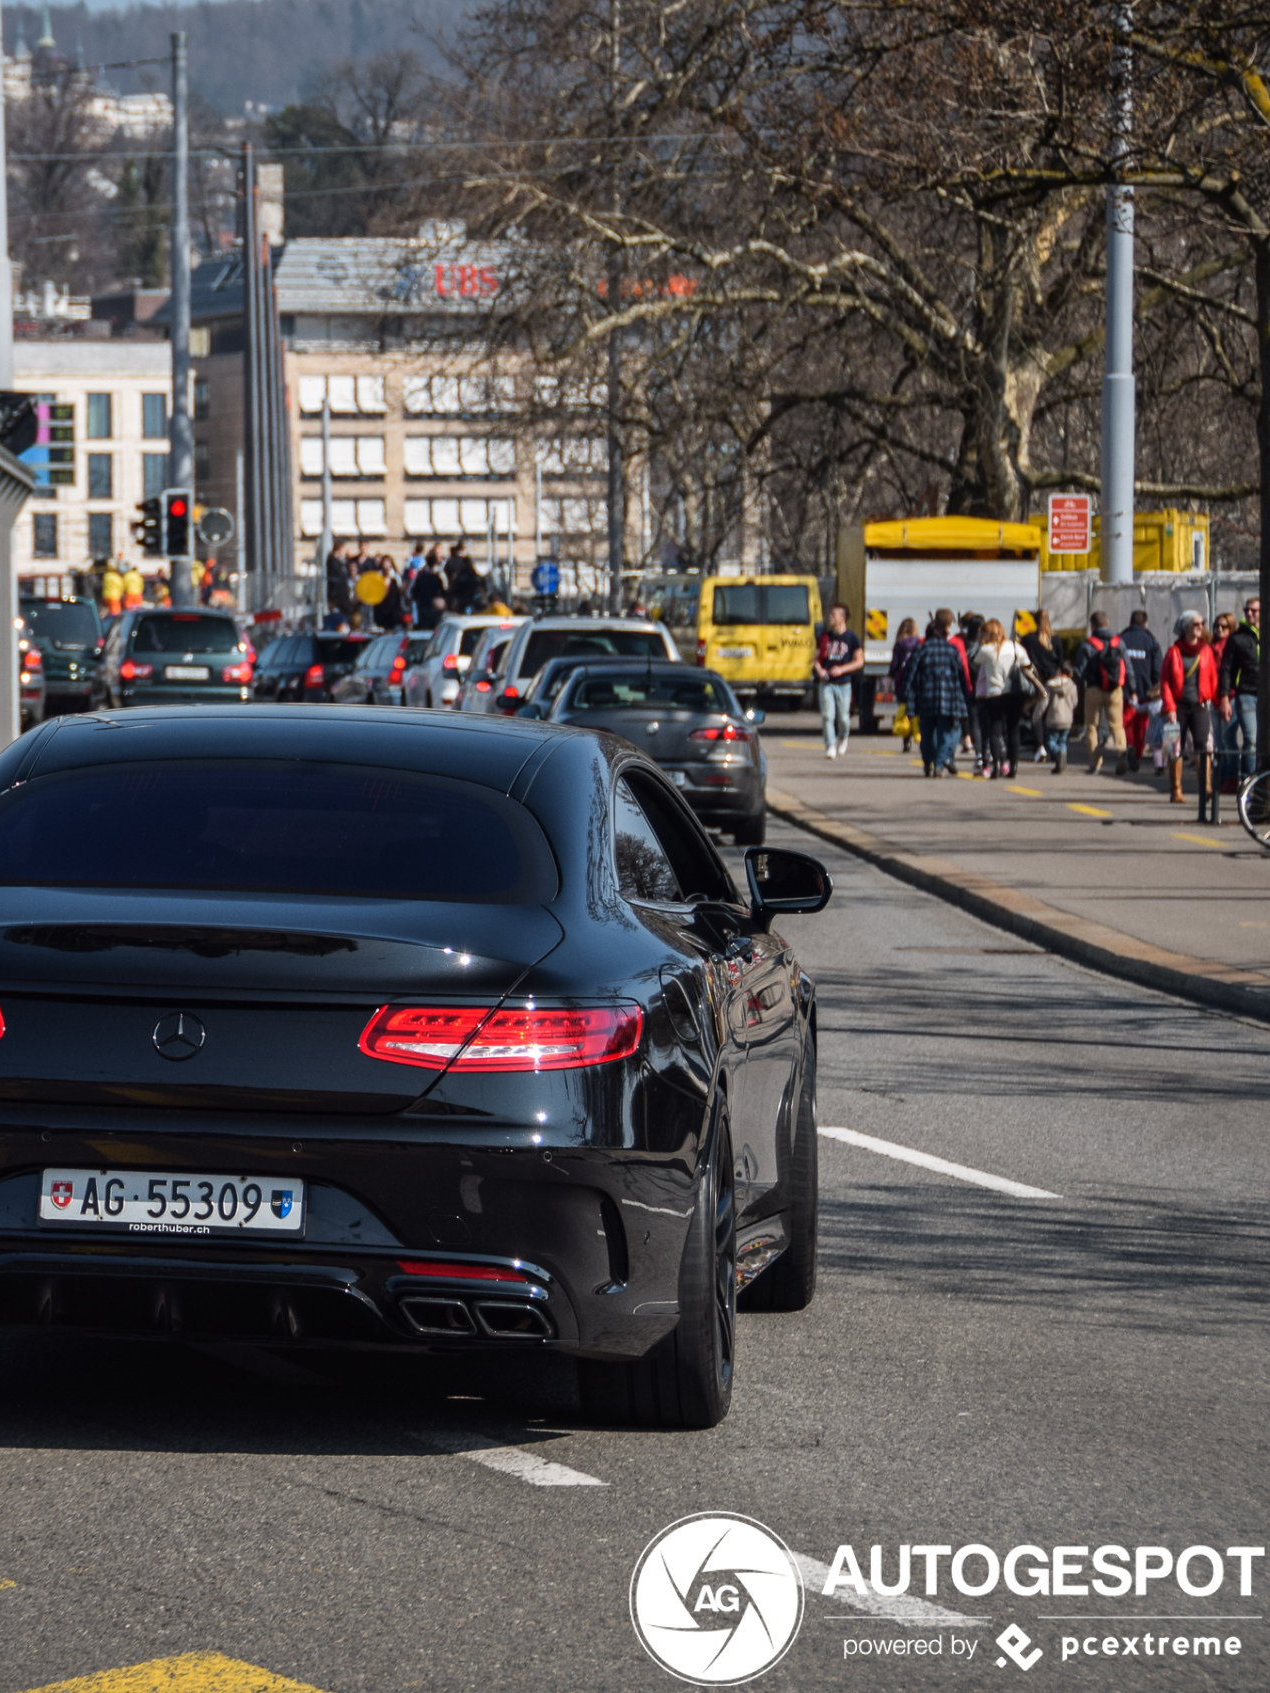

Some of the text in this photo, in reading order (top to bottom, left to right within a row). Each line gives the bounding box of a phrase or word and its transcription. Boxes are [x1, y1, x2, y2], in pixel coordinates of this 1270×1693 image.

[434, 263, 500, 299] UBS
[146, 1178, 263, 1223] 55309
[128, 1222, 211, 1235] roberthuber.ch
